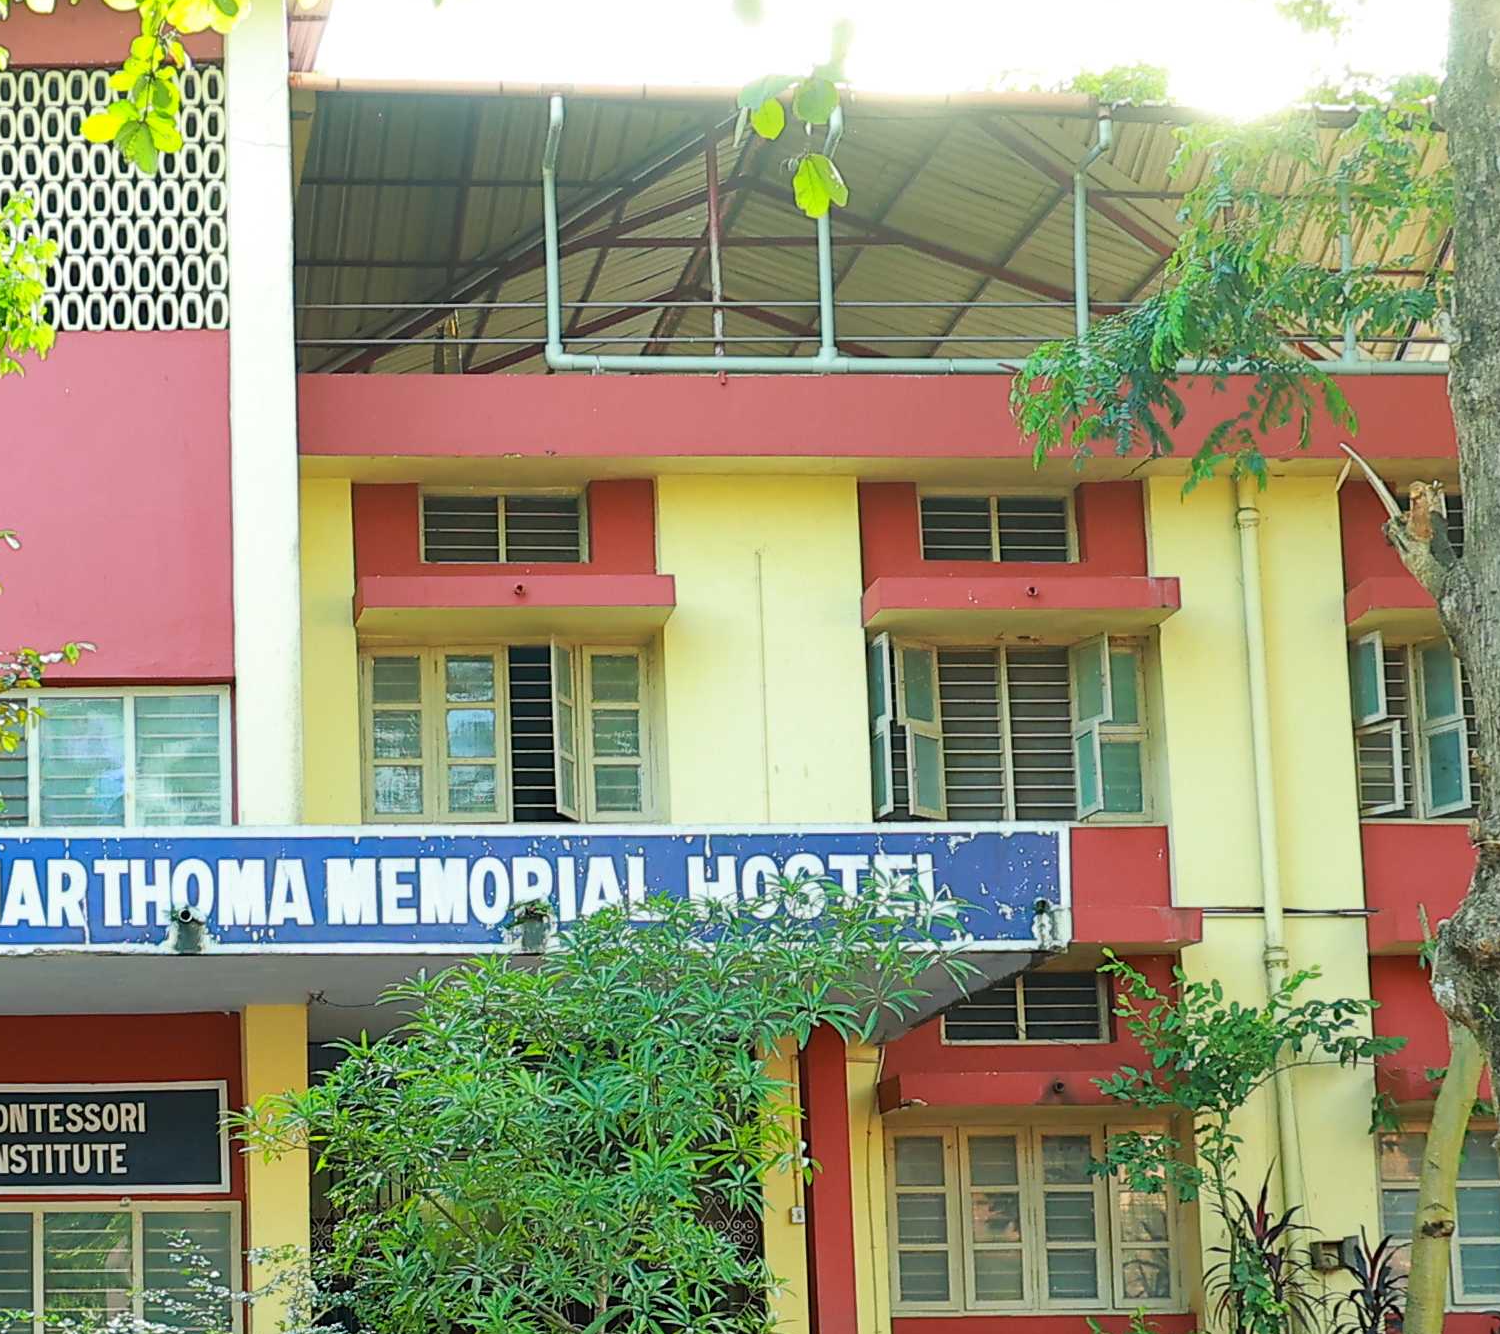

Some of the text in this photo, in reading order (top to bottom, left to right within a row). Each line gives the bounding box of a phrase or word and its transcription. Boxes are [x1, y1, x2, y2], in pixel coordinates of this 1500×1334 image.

[94, 858, 314, 927] THOMA
[326, 856, 667, 926] MEMORIAL
[687, 853, 957, 921] HOSTEL
